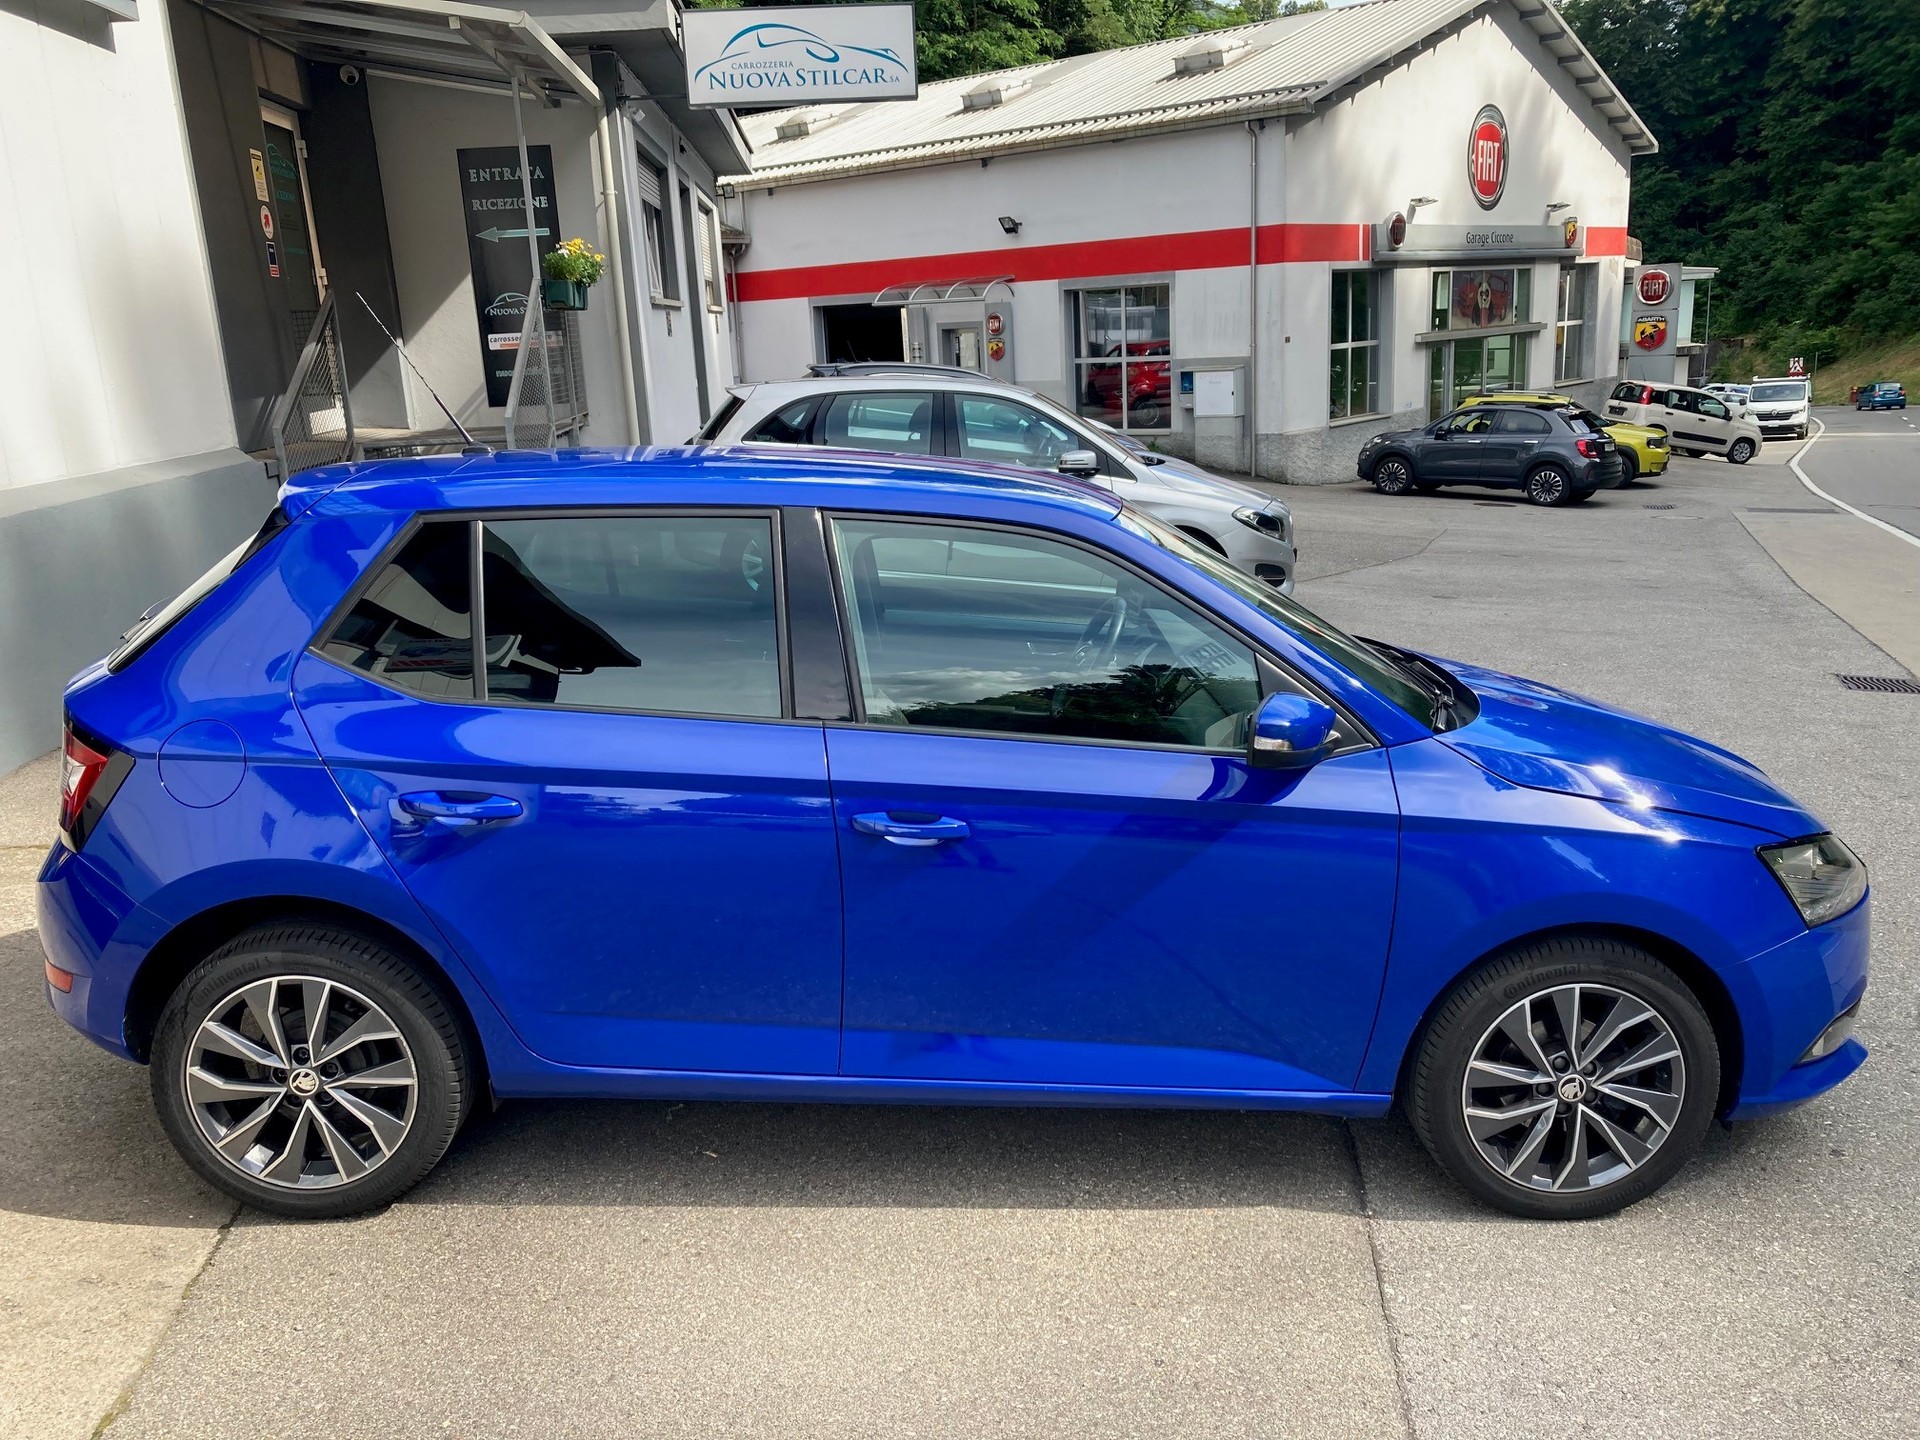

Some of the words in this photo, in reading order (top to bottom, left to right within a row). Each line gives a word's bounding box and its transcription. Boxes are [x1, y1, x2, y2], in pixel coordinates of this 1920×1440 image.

[731, 61, 794, 70] CARROZZERIA
[709, 71, 792, 90] NUOVA
[796, 67, 888, 87] STILCAR
[889, 75, 900, 83] SA
[1478, 140, 1500, 182] FIAT
[1466, 232, 1490, 247] Garage
[1491, 231, 1514, 244] Ciccone
[1642, 280, 1665, 297] FIAT
[489, 308, 520, 316] NUOVA
[1503, 962, 1581, 999] Continental
